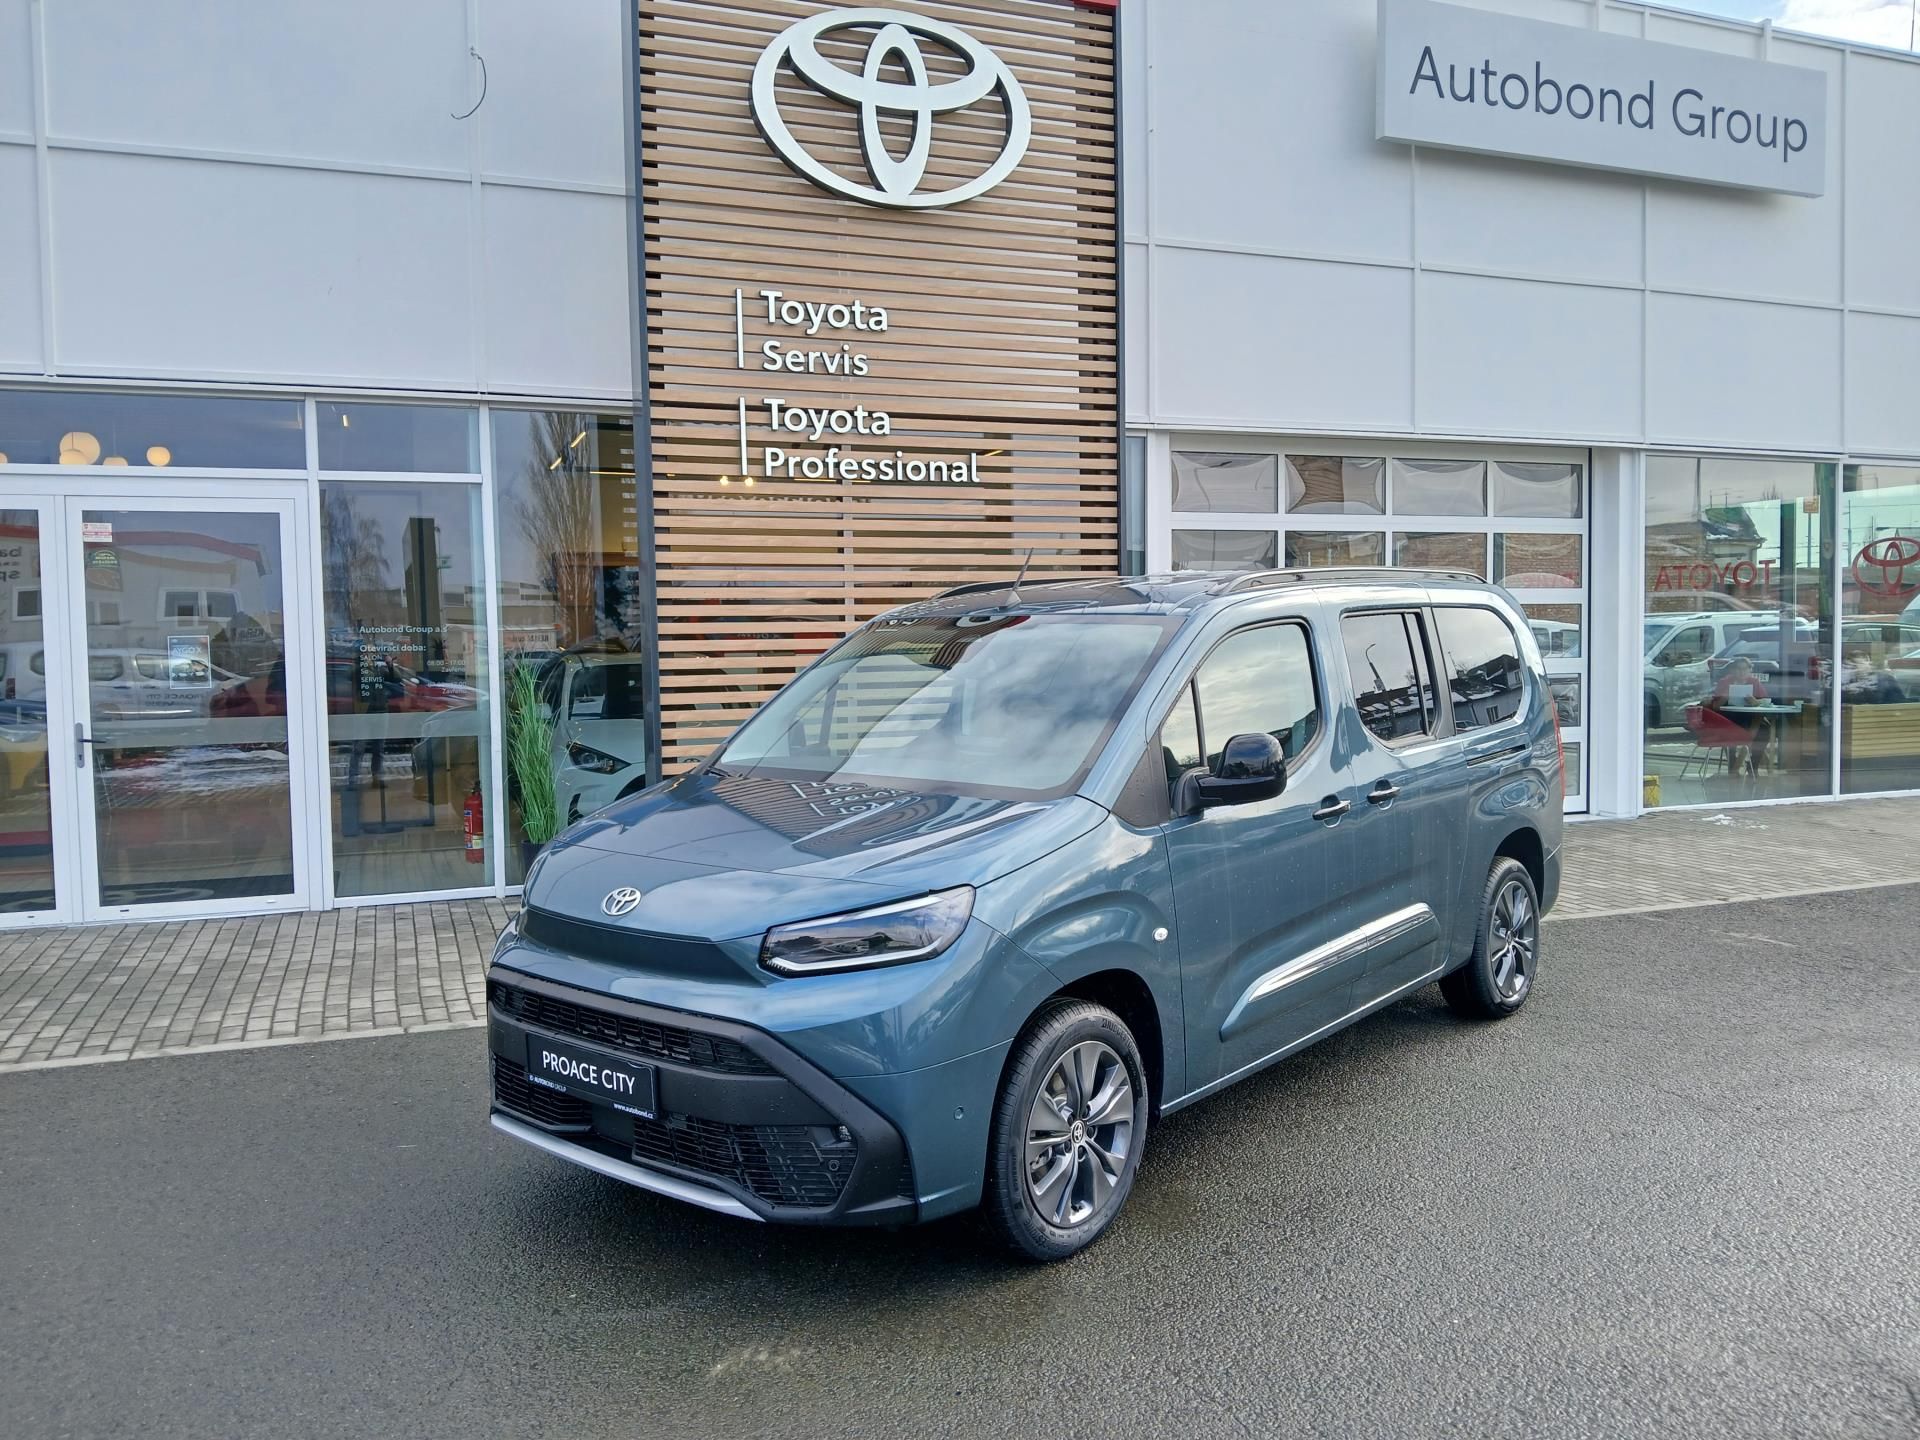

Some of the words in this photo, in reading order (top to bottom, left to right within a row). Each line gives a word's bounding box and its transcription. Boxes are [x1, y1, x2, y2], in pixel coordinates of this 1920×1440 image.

[1409, 45, 1655, 130] Autobond
[1671, 87, 1808, 162] Group
[760, 289, 888, 335] Toyota
[762, 340, 869, 376] Servis
[763, 398, 891, 441] Toyota
[764, 447, 980, 483] Professional
[360, 625, 403, 633] Autobond
[405, 626, 433, 635] Group
[401, 644, 427, 652] doba:
[542, 1050, 598, 1085] PROACE
[601, 1069, 635, 1095] CITY
